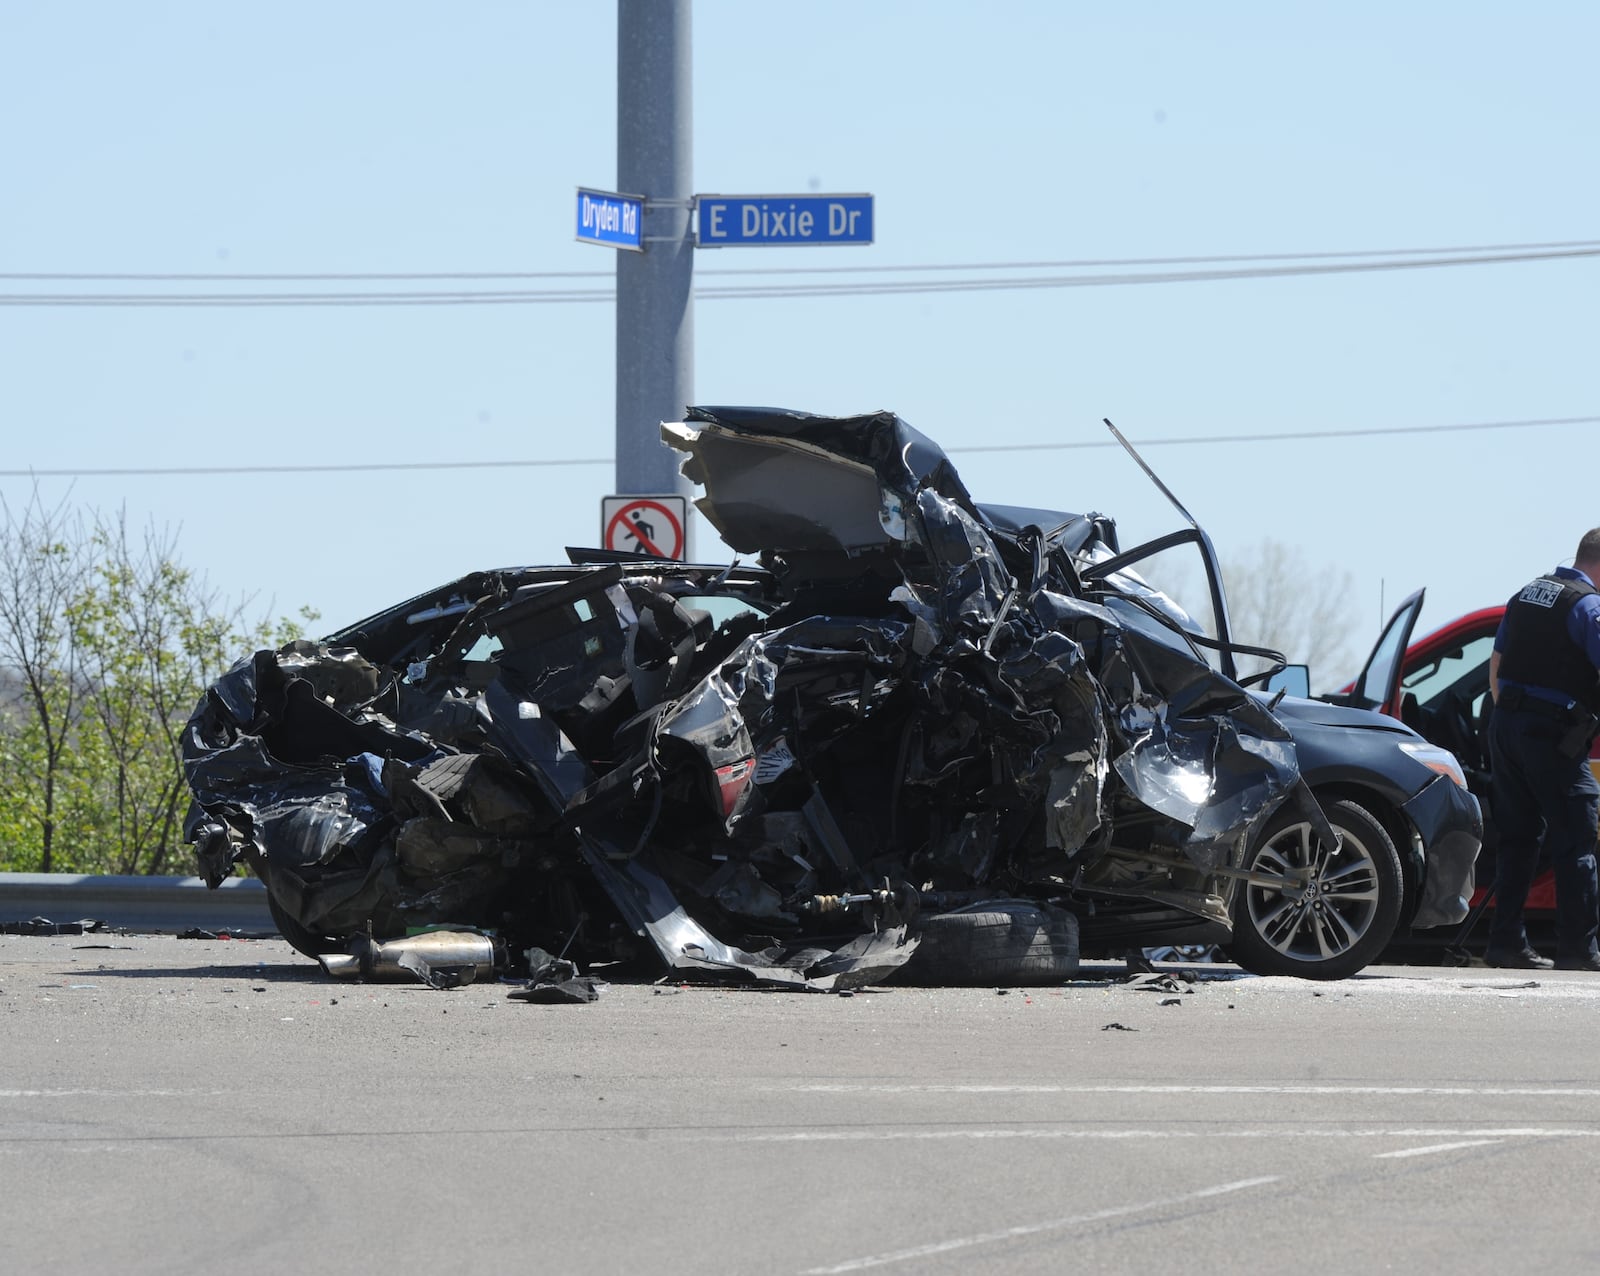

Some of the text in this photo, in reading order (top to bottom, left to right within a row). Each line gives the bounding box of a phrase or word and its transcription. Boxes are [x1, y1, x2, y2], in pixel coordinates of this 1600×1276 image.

[583, 195, 637, 238] Dryden Rd
[710, 203, 862, 237] E Dixie Dr
[1521, 587, 1557, 605] POLICE
